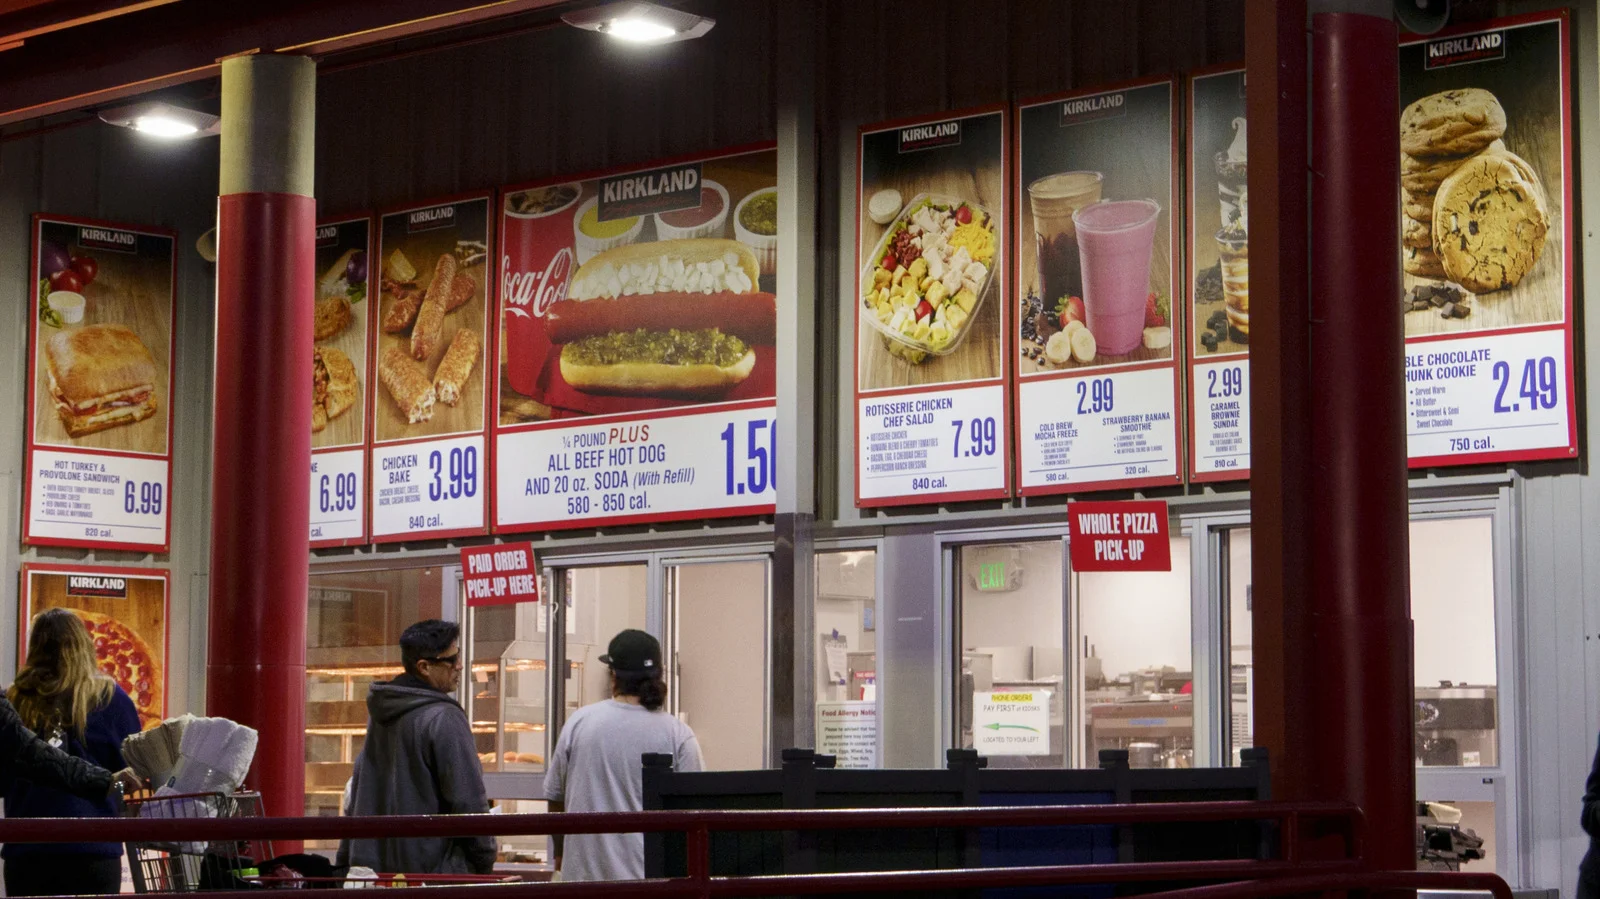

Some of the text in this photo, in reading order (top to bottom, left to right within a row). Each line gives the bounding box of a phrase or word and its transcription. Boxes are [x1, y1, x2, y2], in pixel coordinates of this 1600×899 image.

[1429, 33, 1502, 58] KIRKLAND
[1063, 94, 1124, 116] KIRKLAND
[902, 122, 959, 143] KIRKLAND
[603, 168, 699, 204] KIRKLAND
[410, 206, 454, 224] KIRKLAND
[82, 228, 134, 245] KIRKLAND
[316, 227, 337, 240] LAND
[1404, 348, 1491, 368] BLE CHOCOLATE
[1404, 364, 1477, 382] HUNK COOKIE
[1208, 367, 1242, 399] 2.99
[1415, 386, 1446, 396] Served Warm
[1492, 356, 1558, 414] 2.49
[1076, 378, 1114, 415] 2.99
[865, 397, 953, 417] ROTISSERIE CHICKEN
[1210, 401, 1240, 411] CARAMEL
[883, 412, 935, 428] CHEF SALAD
[1102, 411, 1171, 426] STRAWBERRY BANANA
[1211, 410, 1240, 420] BROWNIE
[1039, 421, 1073, 432] COLD BREW
[1120, 422, 1152, 433] SMOOTHIE
[1213, 419, 1238, 429] SUNDAE
[573, 431, 606, 449] POUND
[609, 424, 650, 445] PLUS
[951, 416, 996, 458] 7.99
[1034, 429, 1079, 441] MOCHA FREEZE
[1450, 436, 1495, 451] 750 cal.
[54, 460, 106, 473] HOT TURKEY &
[382, 454, 418, 471] CHICKEN
[547, 444, 666, 472] ALL BEEF HOT DOG
[1214, 459, 1238, 468] 810 cal.
[39, 470, 120, 484] PROVOLONE SANDWICH
[389, 470, 411, 484] BAKE
[429, 446, 477, 502] 3.99
[1045, 472, 1069, 481] 580 cal.
[1125, 465, 1150, 475] 320 cal.
[525, 467, 695, 496] AND 20 oz. SODA (With Refill)
[912, 476, 947, 490] 840 cal.
[124, 480, 162, 515] 6.99
[320, 472, 356, 513] 6.99
[567, 497, 590, 515] 580
[602, 493, 625, 511] 850
[629, 491, 652, 509] cal.
[409, 513, 444, 529] 840 cal.
[1078, 512, 1159, 535] WHOLE PIZZA
[85, 528, 114, 538] 820 cal.
[1094, 539, 1144, 561] PICK-UP
[468, 549, 528, 574] PAID ORDER
[70, 576, 125, 590] KIRKLAND
[981, 562, 1005, 589] EXIT
[466, 574, 536, 599] PICK-UP HERE
[991, 693, 1033, 702] PHONE ORDERS
[983, 704, 995, 712] PAY
[996, 704, 1015, 712] FIRST
